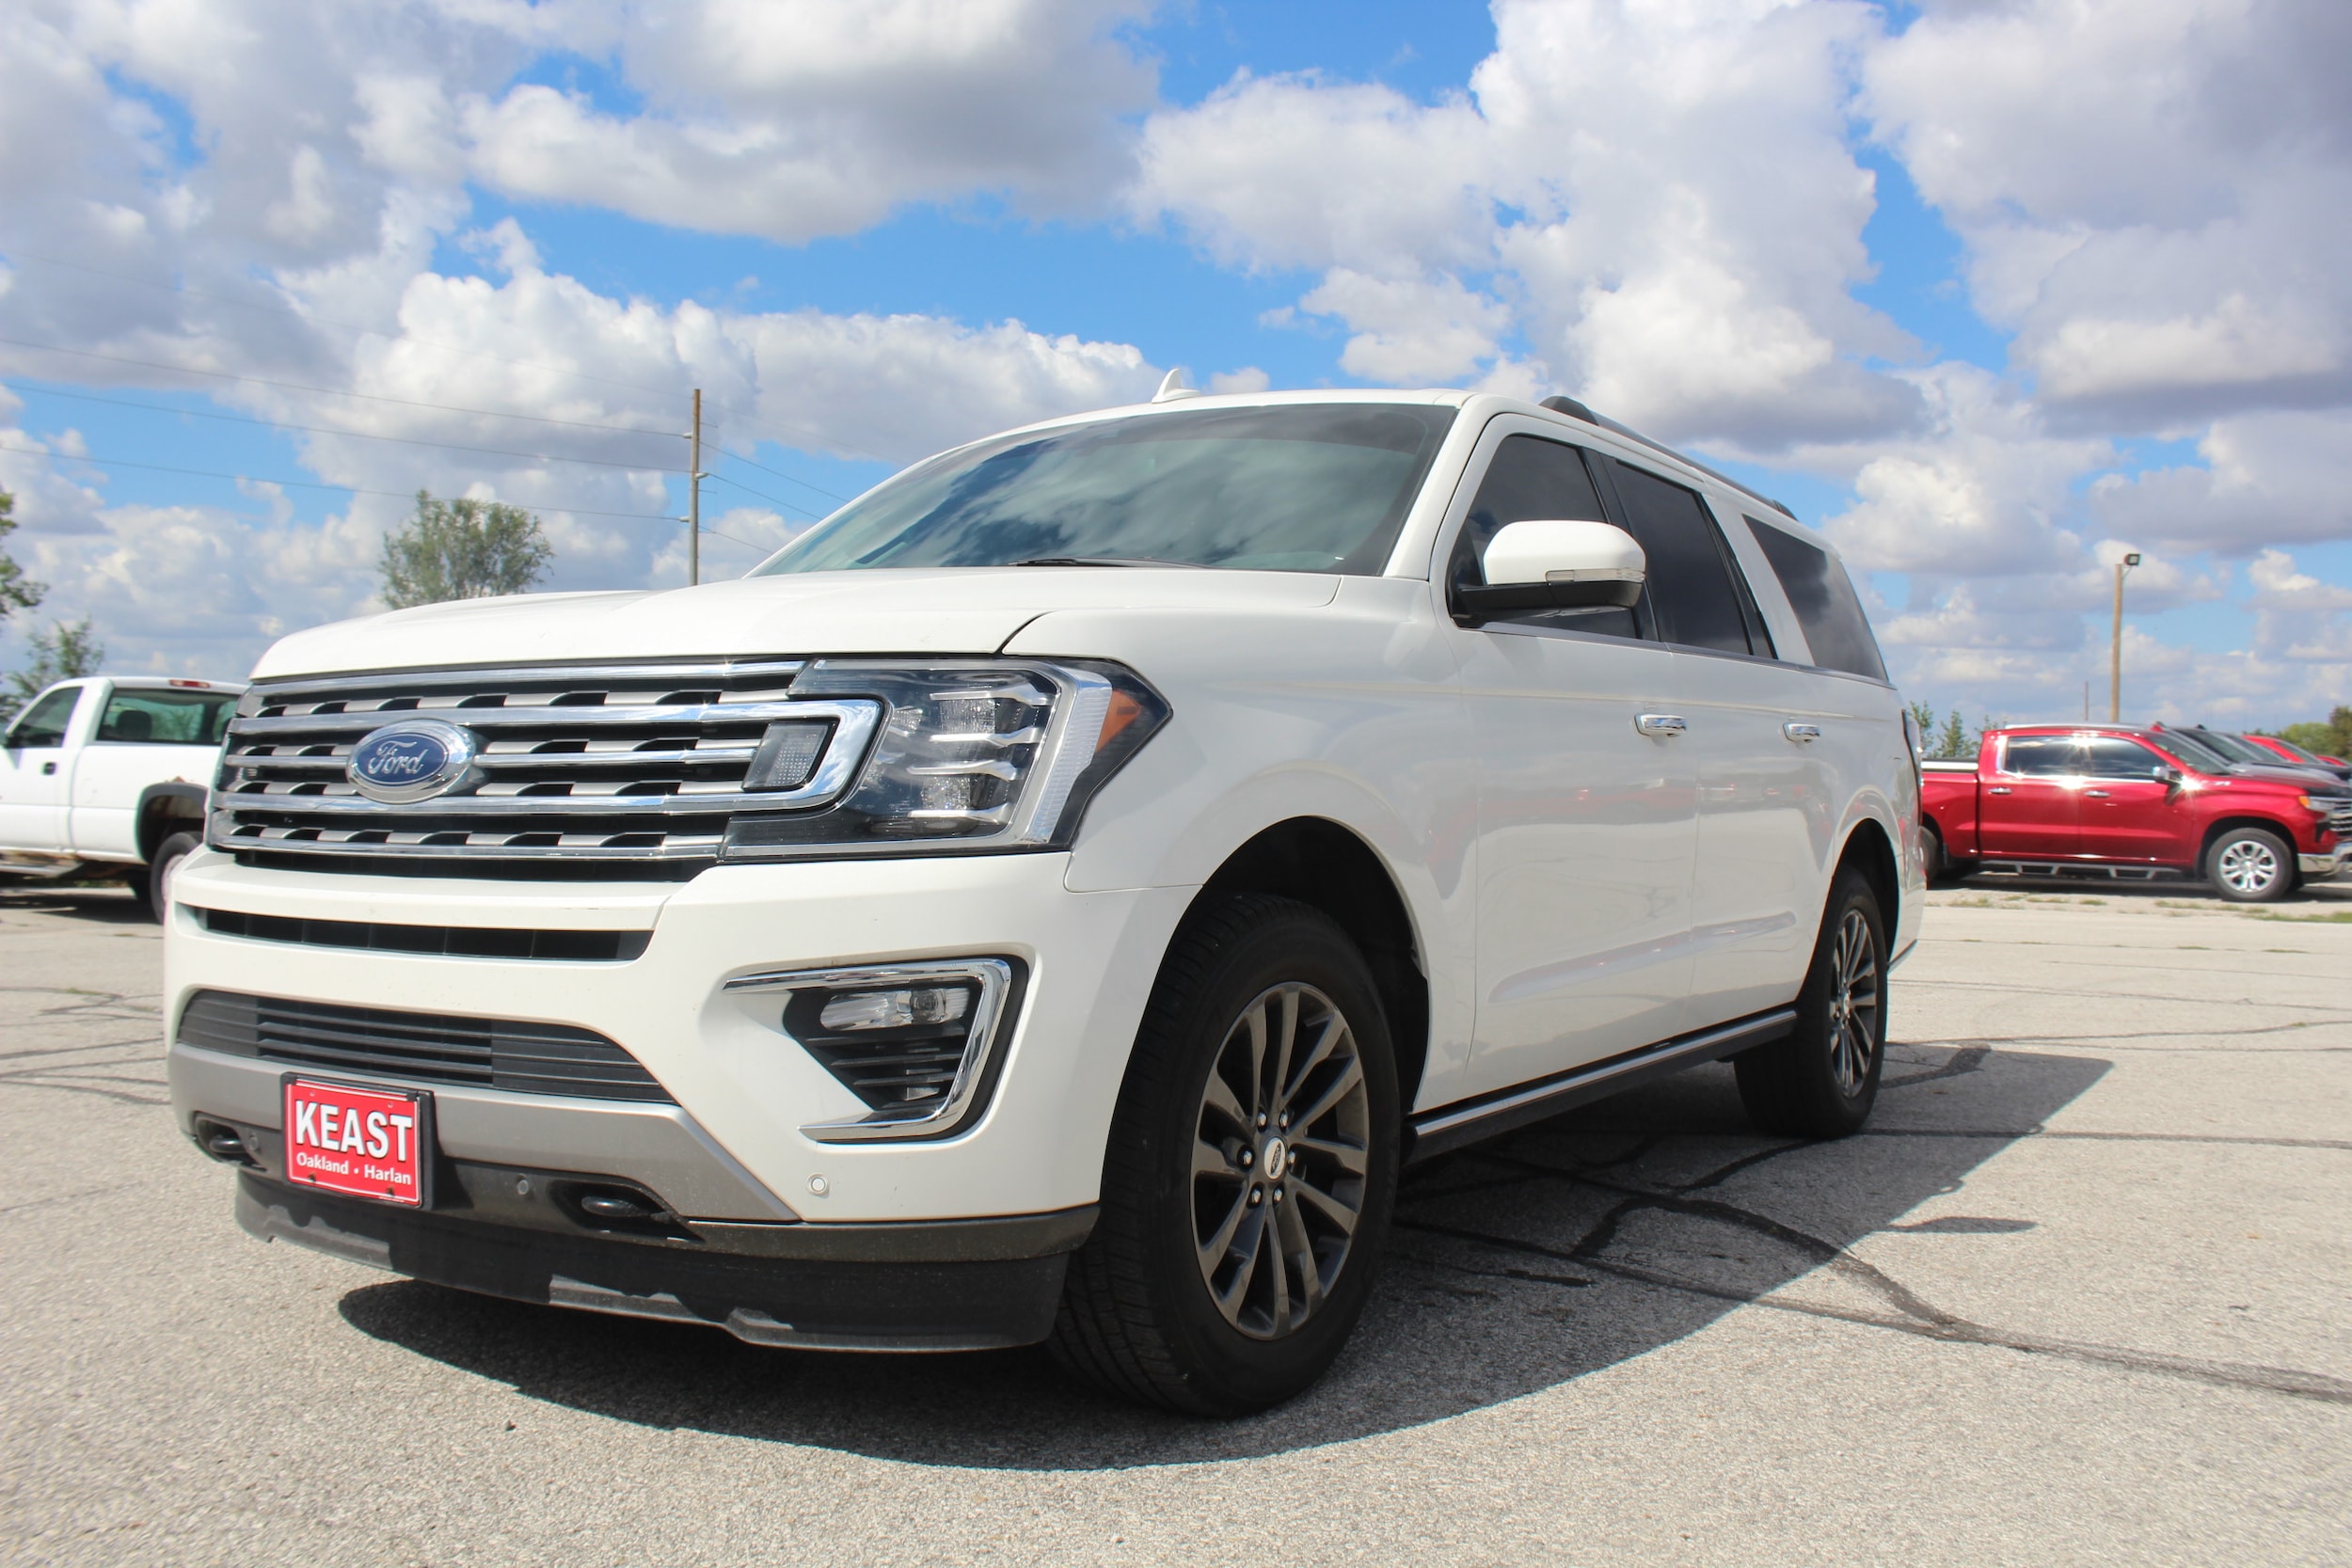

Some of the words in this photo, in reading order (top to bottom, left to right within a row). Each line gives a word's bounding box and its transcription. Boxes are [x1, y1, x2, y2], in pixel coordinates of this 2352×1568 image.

[368, 740, 430, 775] Ford
[295, 1100, 414, 1162] KEAST
[296, 1151, 349, 1175] Oakland
[364, 1164, 411, 1185] Harlan
